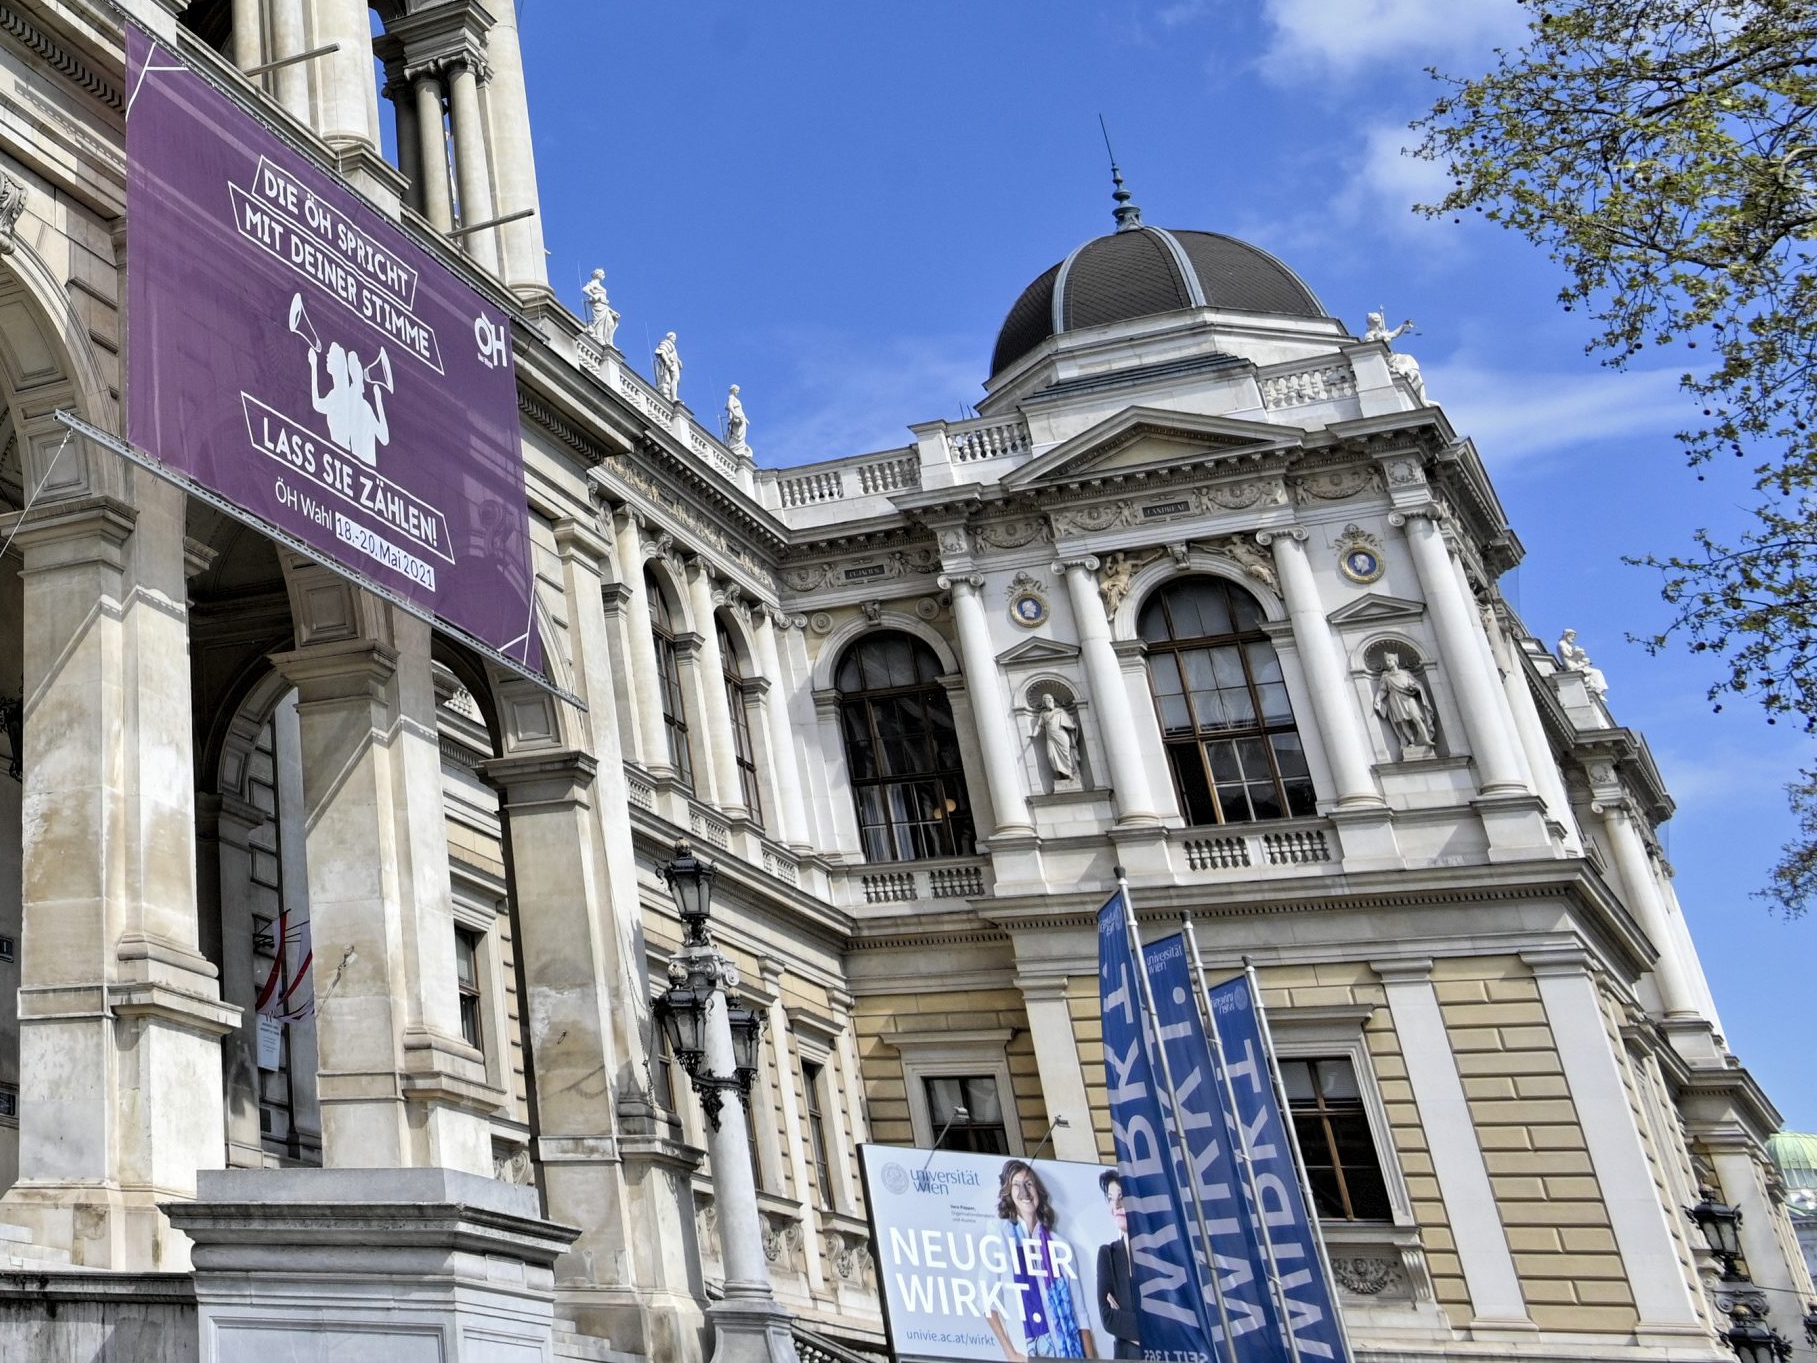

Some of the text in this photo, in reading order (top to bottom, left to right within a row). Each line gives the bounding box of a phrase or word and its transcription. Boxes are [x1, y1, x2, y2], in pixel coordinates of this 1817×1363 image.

[264, 168, 408, 296] DIE ÖH SPRICHT
[245, 202, 430, 358] MIT DEINER STIMME
[264, 417, 438, 547] LASS SIE ZÄHLEN!
[275, 476, 298, 511] ÖH
[300, 493, 333, 530] Wahl
[379, 547, 401, 570] Mai
[403, 555, 434, 588] 2021
[1146, 944, 1183, 966] universität
[1148, 961, 1167, 975] wien
[910, 1169, 981, 1186] universität
[913, 1181, 949, 1195] wien
[889, 1226, 1078, 1280] NEUGIER
[895, 1272, 1042, 1323] WIRKT.
[906, 1330, 996, 1347] univie.ac.at/wirkt
